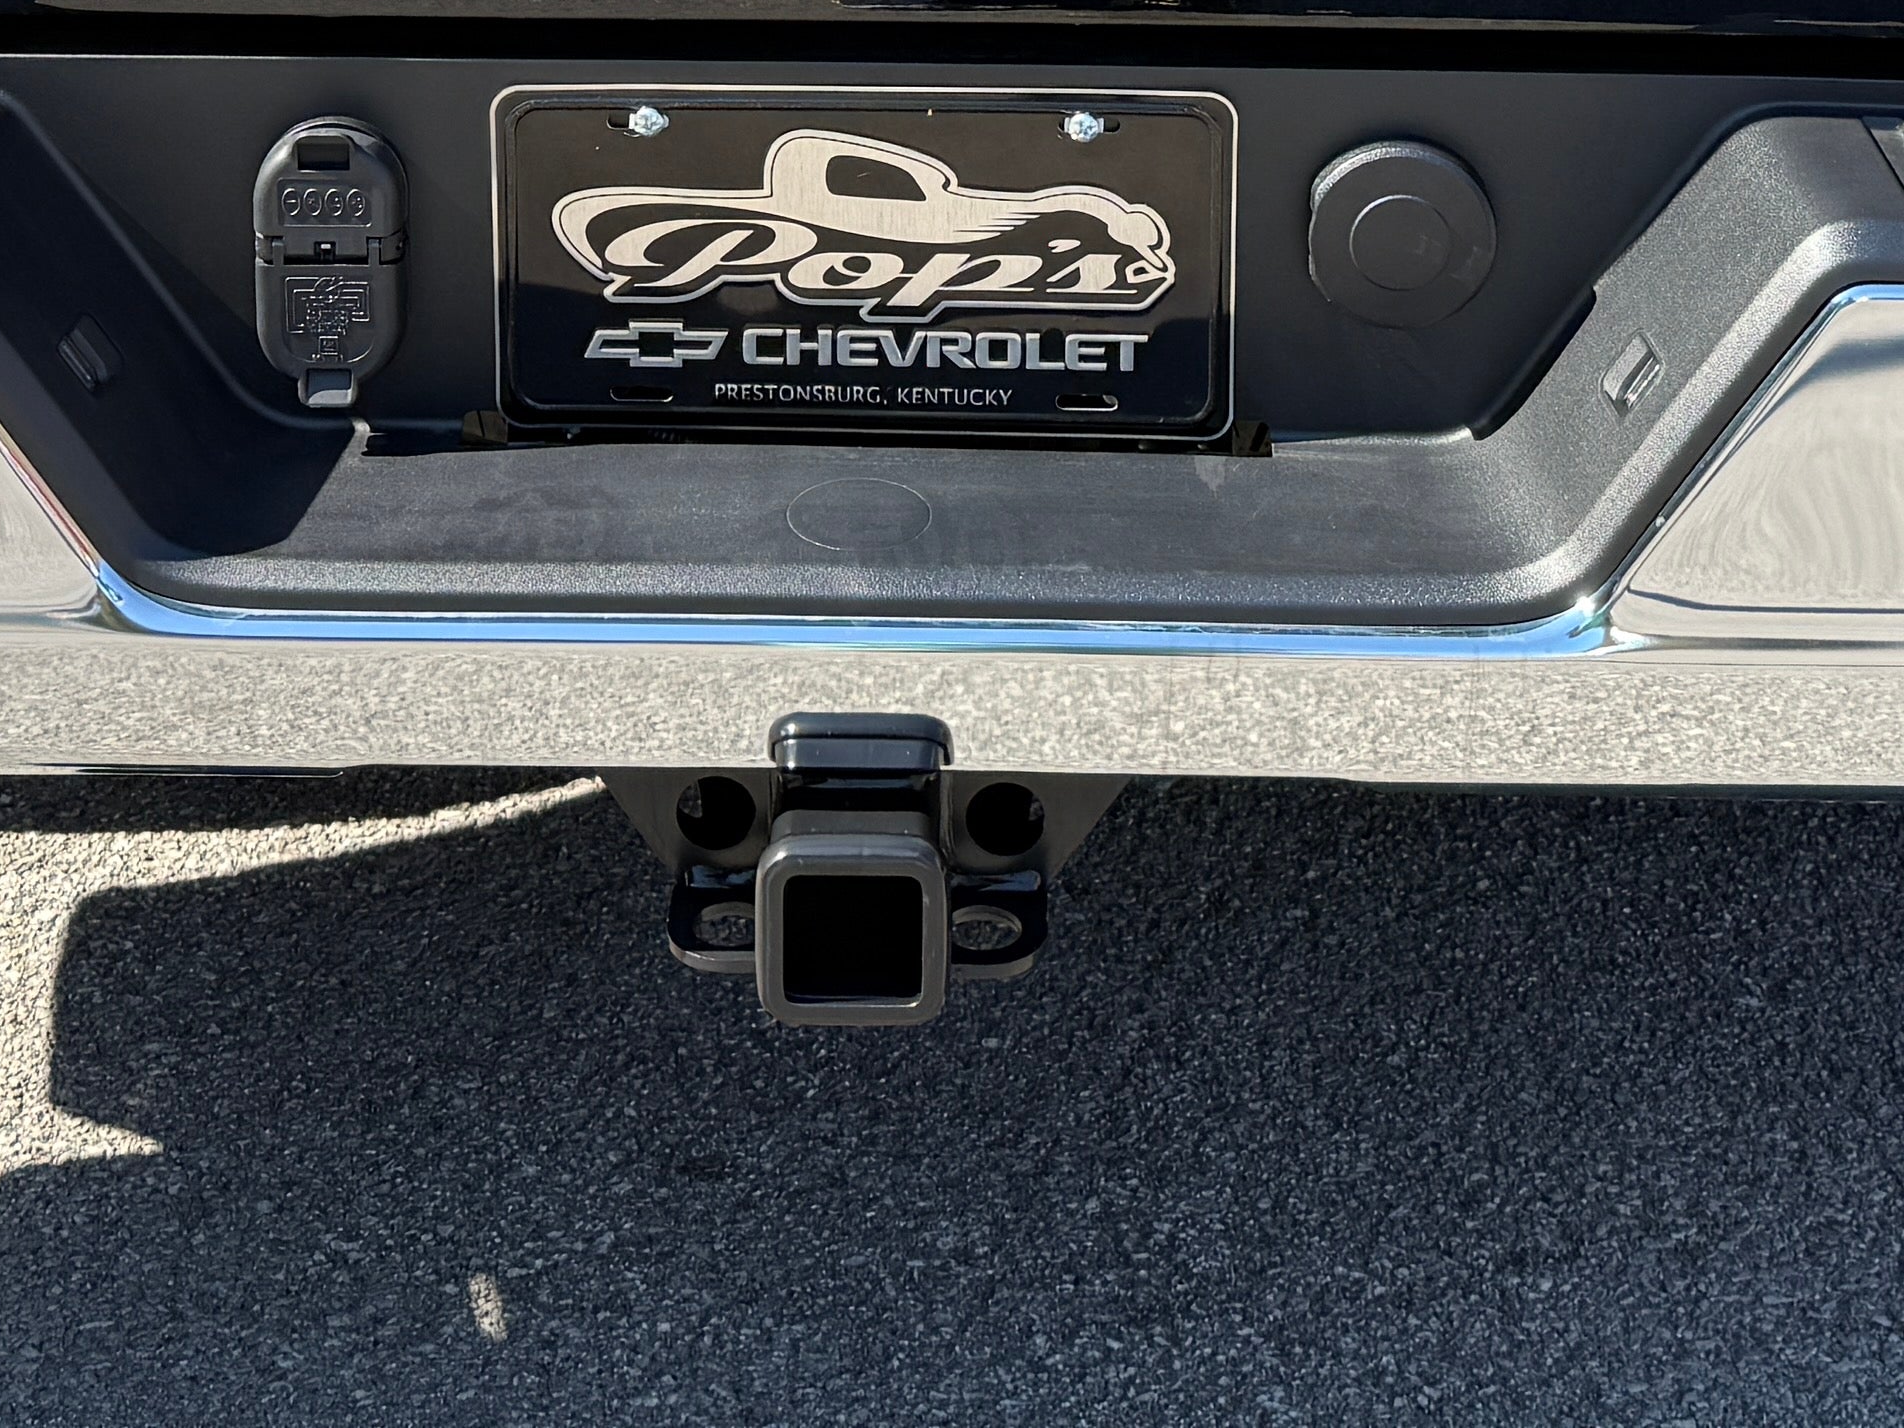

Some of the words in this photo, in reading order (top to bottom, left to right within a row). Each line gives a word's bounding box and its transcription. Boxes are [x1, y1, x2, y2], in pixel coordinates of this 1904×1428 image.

[742, 327, 1149, 373] CHEVROLET
[713, 382, 888, 406] PRESTONSBURG,
[897, 386, 1013, 406] KENTUCKY
